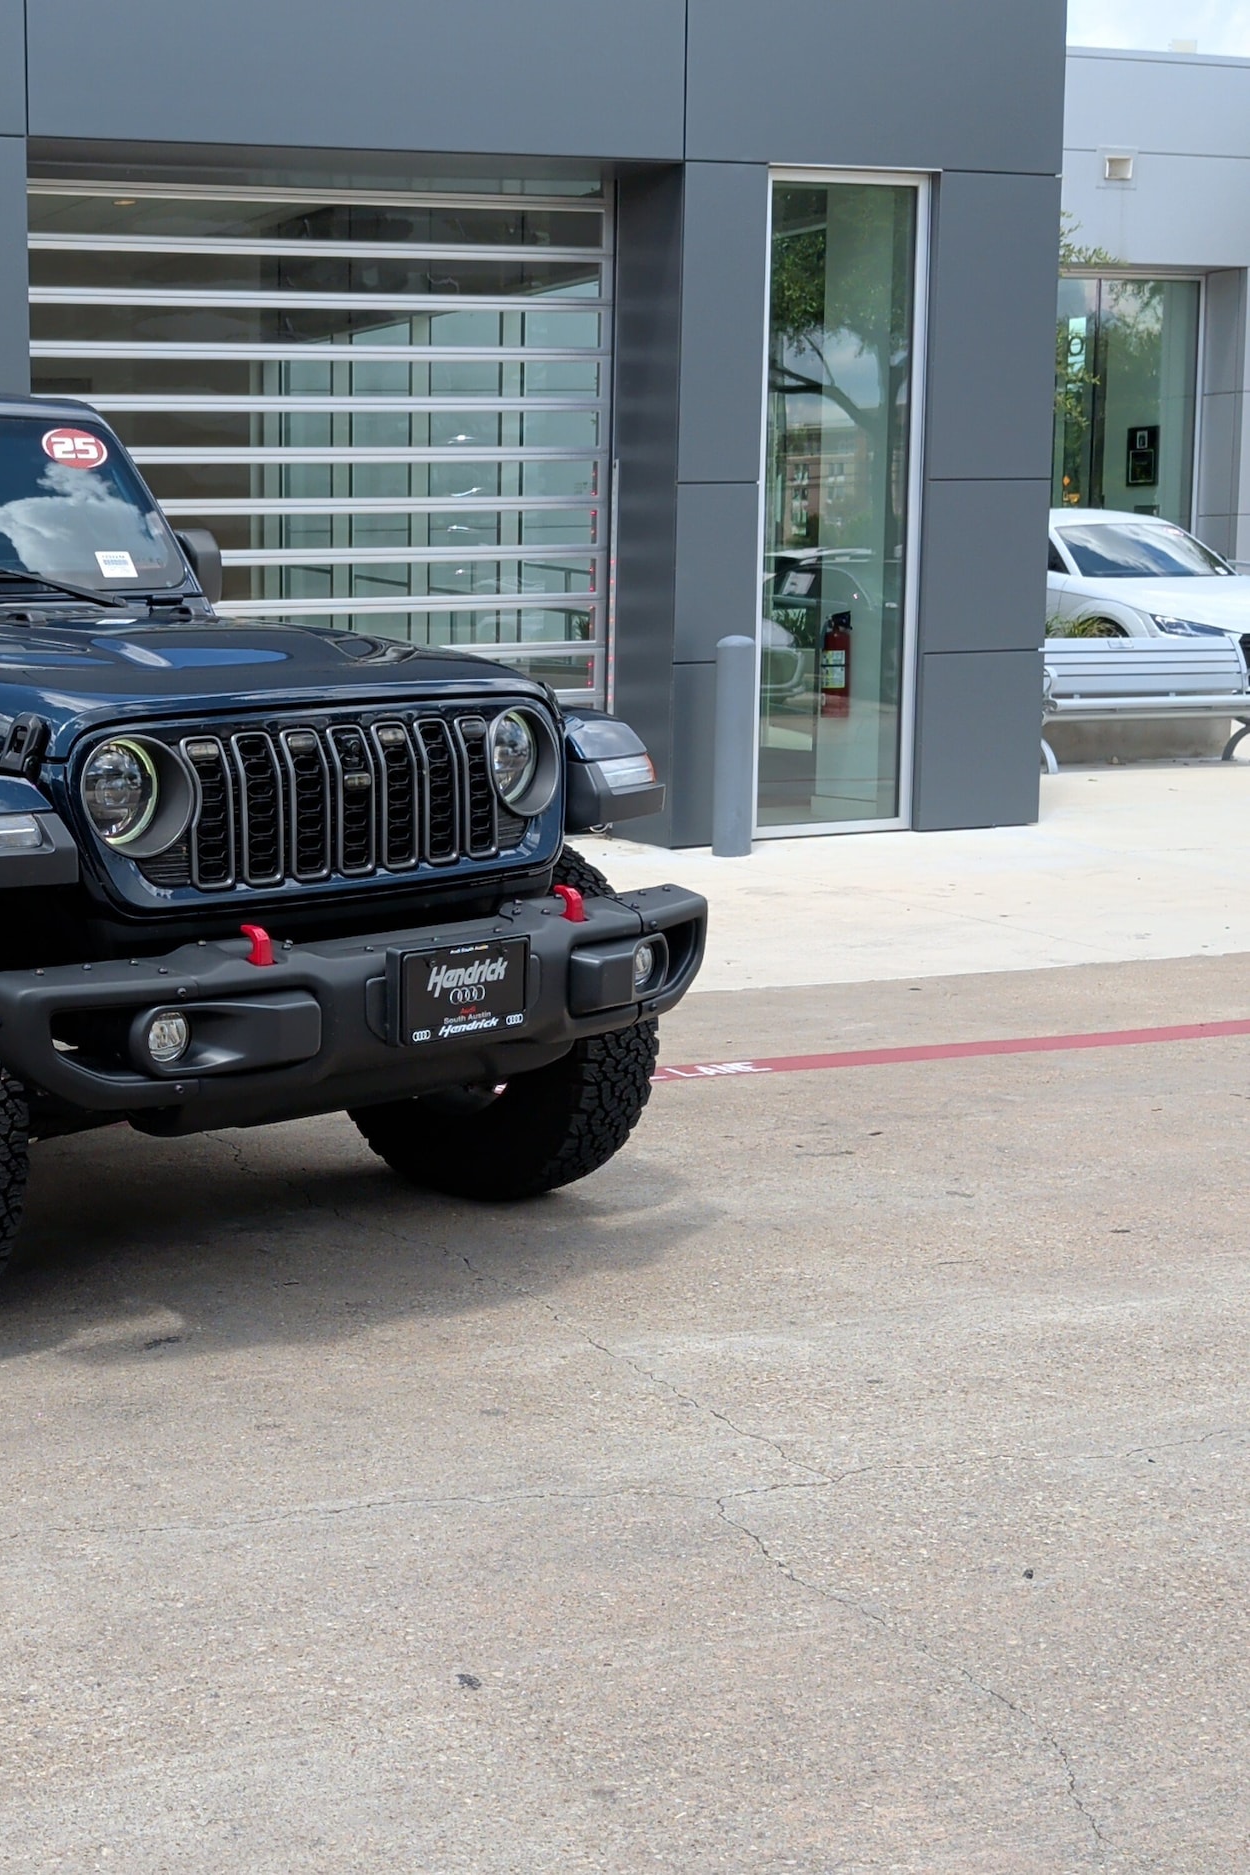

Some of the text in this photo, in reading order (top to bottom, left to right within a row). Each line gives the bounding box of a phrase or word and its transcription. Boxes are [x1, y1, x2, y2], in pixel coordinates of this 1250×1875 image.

[51, 437, 98, 459] 25
[427, 957, 508, 998] Hendrick
[438, 1016, 500, 1038] Hendrick
[443, 1010, 491, 1025] South Austin
